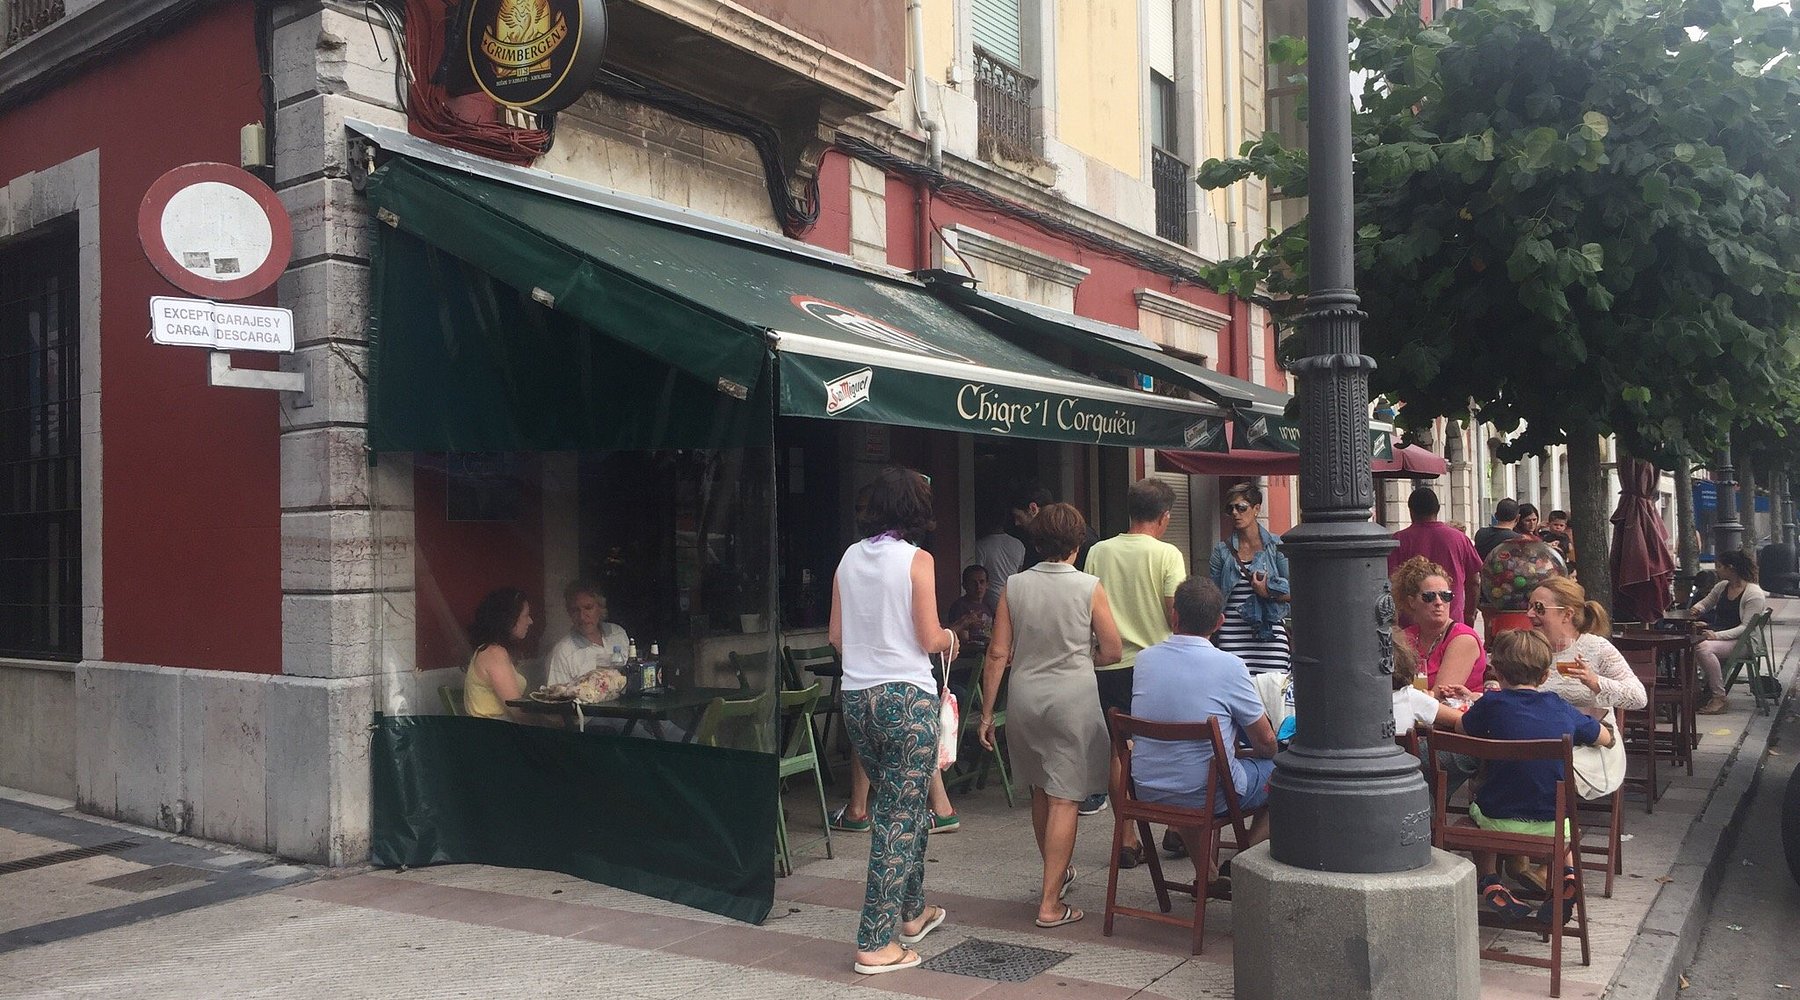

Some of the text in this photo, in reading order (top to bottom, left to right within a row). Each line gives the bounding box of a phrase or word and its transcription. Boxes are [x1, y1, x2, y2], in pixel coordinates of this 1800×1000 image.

[486, 31, 561, 62] GRIMBERGEN
[217, 313, 271, 328] GARAJES
[273, 318, 281, 328] Y
[166, 323, 281, 344] CARGA DESCARGA
